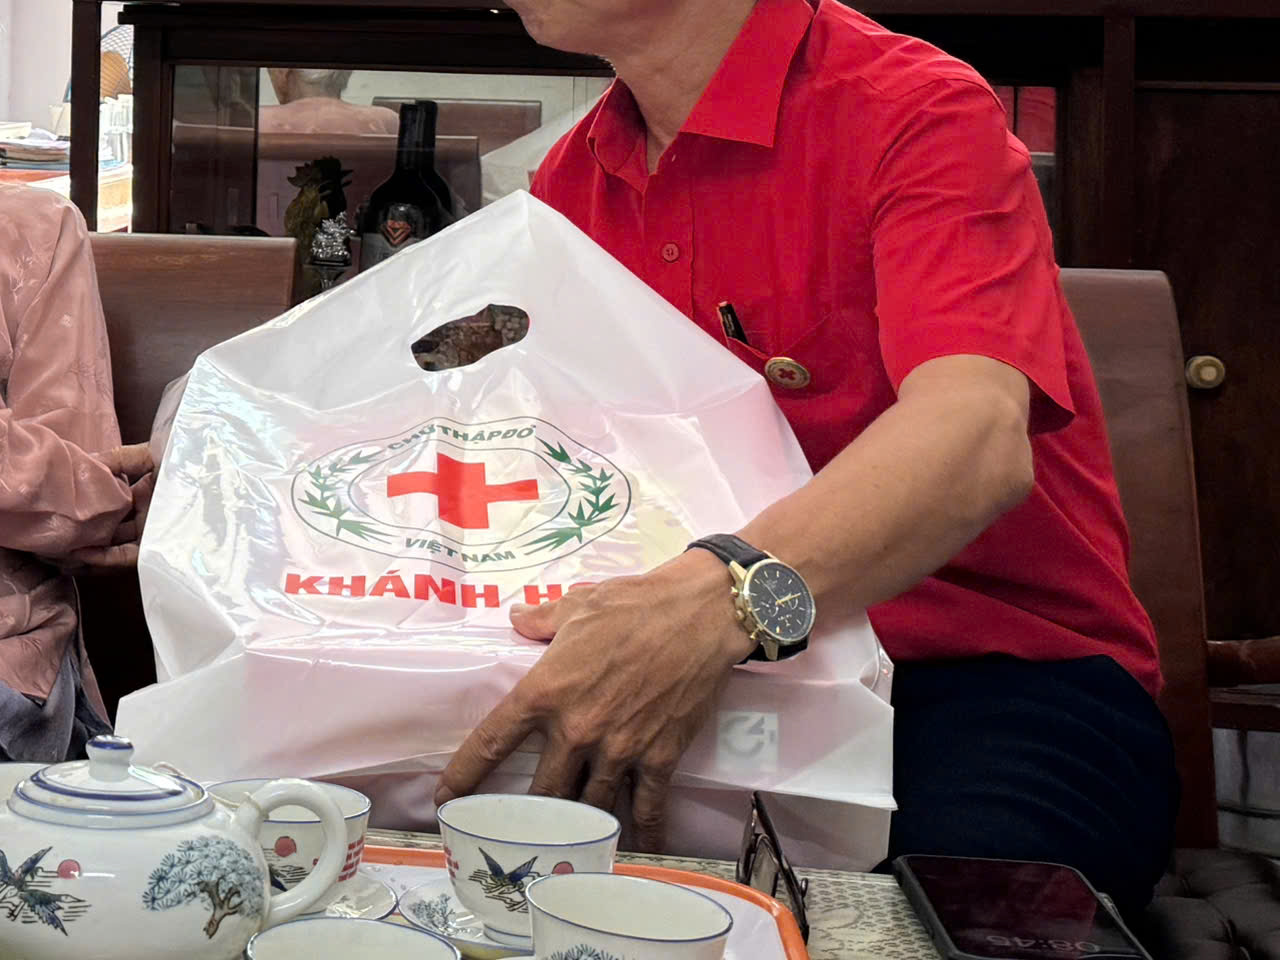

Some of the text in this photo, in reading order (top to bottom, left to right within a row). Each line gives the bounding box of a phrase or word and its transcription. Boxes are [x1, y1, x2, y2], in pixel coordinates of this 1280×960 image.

[405, 537, 517, 563] VIỆT NAM
[284, 569, 500, 608] KHÁNH
